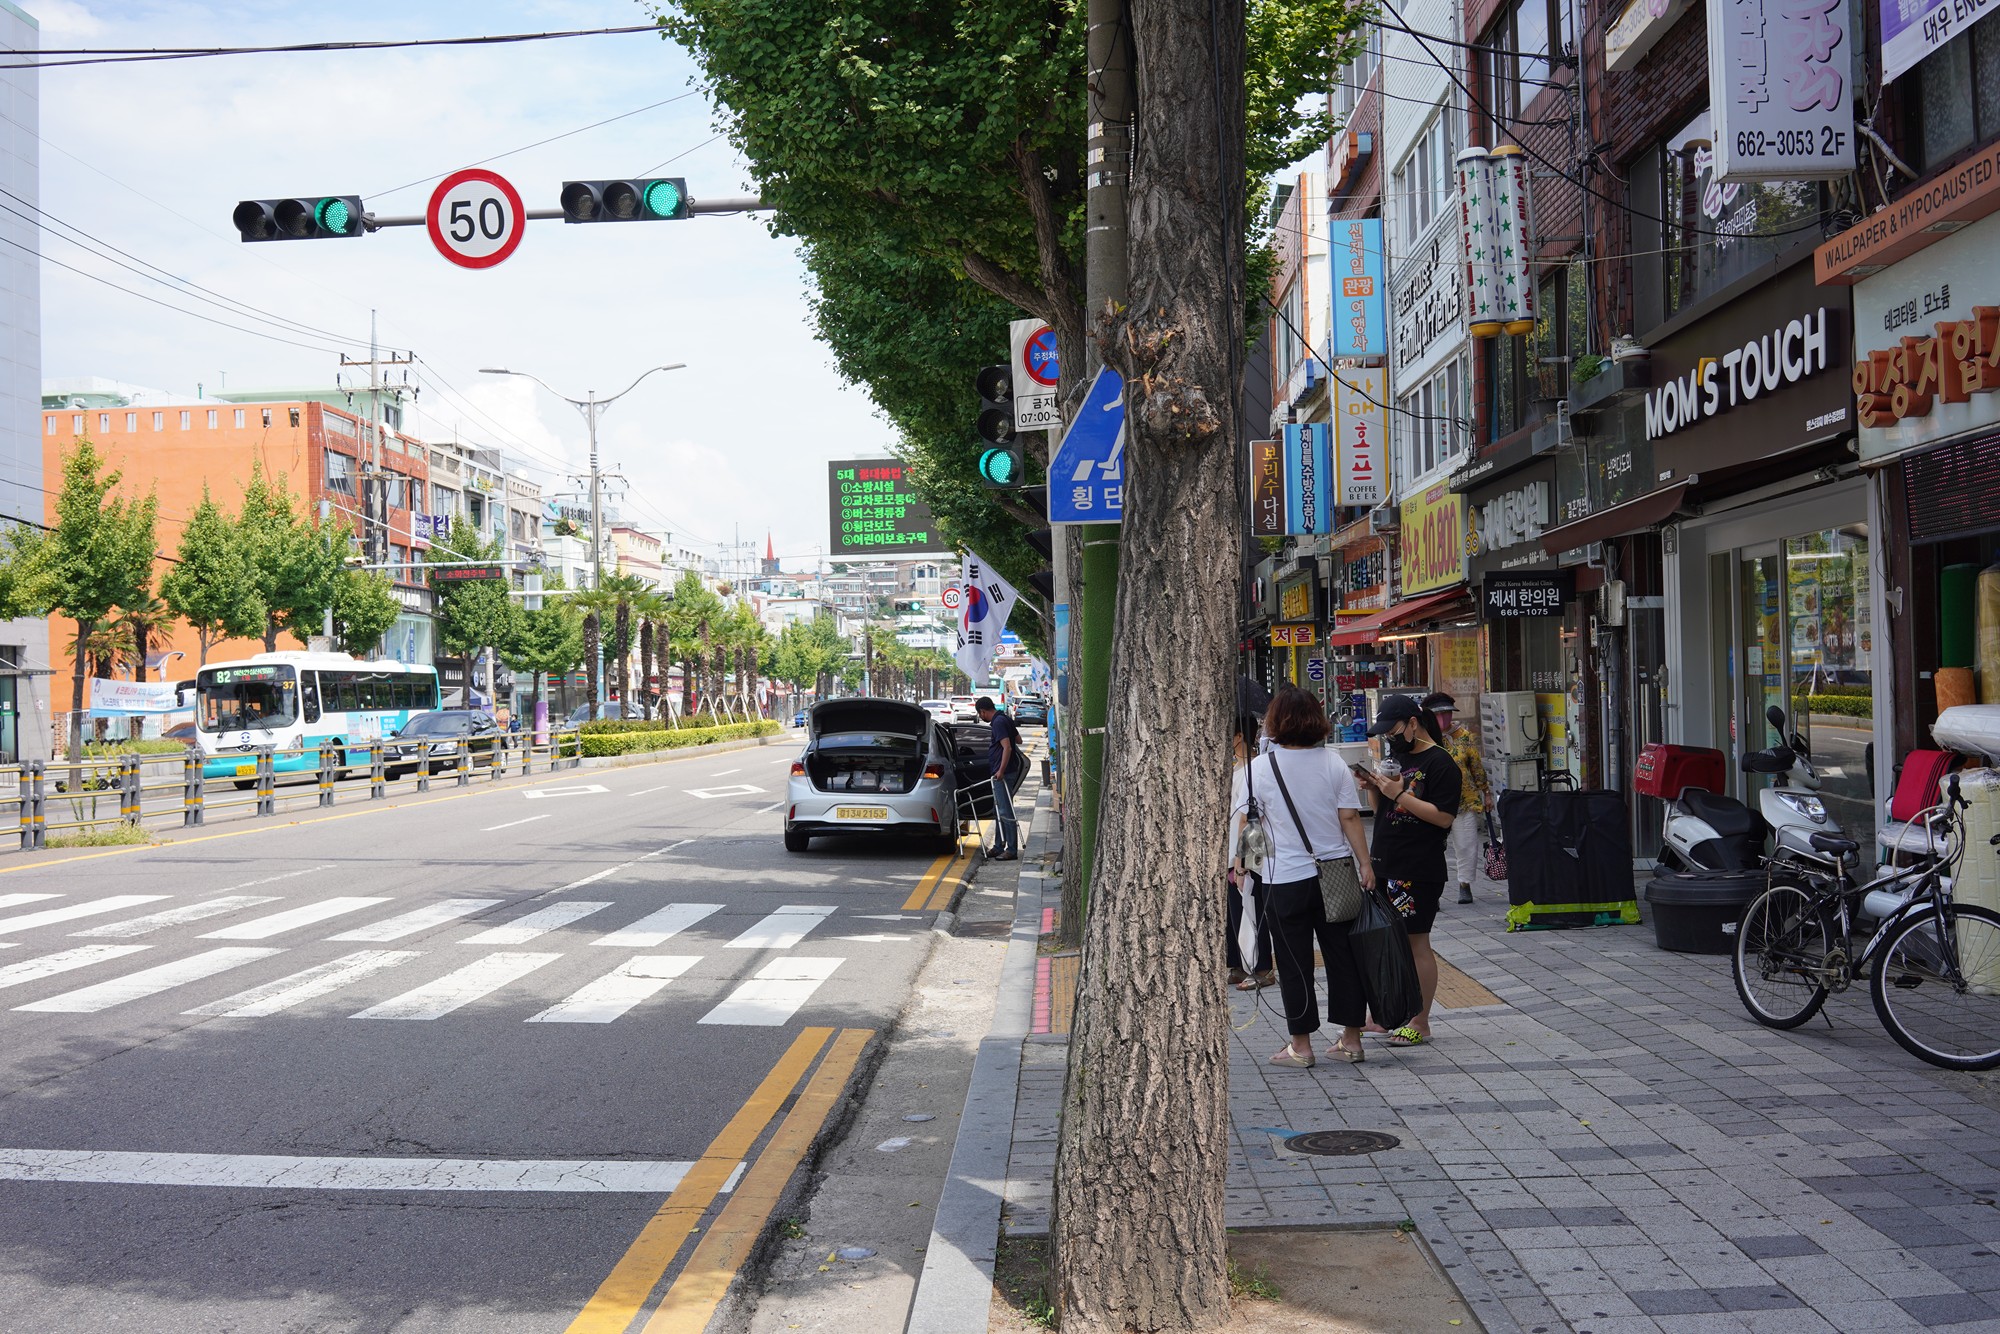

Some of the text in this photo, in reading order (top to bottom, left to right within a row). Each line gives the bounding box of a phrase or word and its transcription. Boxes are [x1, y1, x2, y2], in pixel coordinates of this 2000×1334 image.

[1923, 6, 1952, 44] 대우
[1737, 125, 1845, 156] 662-3053 2F
[450, 198, 504, 242] 50
[1825, 158, 1992, 269] WALLPAPER & HYPOCAUSTED
[1348, 223, 1364, 275] 신제일
[1345, 279, 1372, 296] 관광
[1924, 284, 1951, 316] 모노륨
[1351, 300, 1368, 352] 여행사
[1645, 307, 1826, 441] MOM'S TOUCH
[836, 468, 855, 480] 5대
[1301, 428, 1315, 530] 제일특수방수공사
[1348, 485, 1377, 493] COFFEE
[1423, 500, 1458, 584] 10,800
[946, 593, 959, 603] 50
[1489, 588, 1559, 607] 제세 한의원
[1500, 608, 1548, 616] 666-1075
[1275, 627, 1312, 644] 저울
[216, 670, 231, 683] 82
[283, 681, 295, 690] 37
